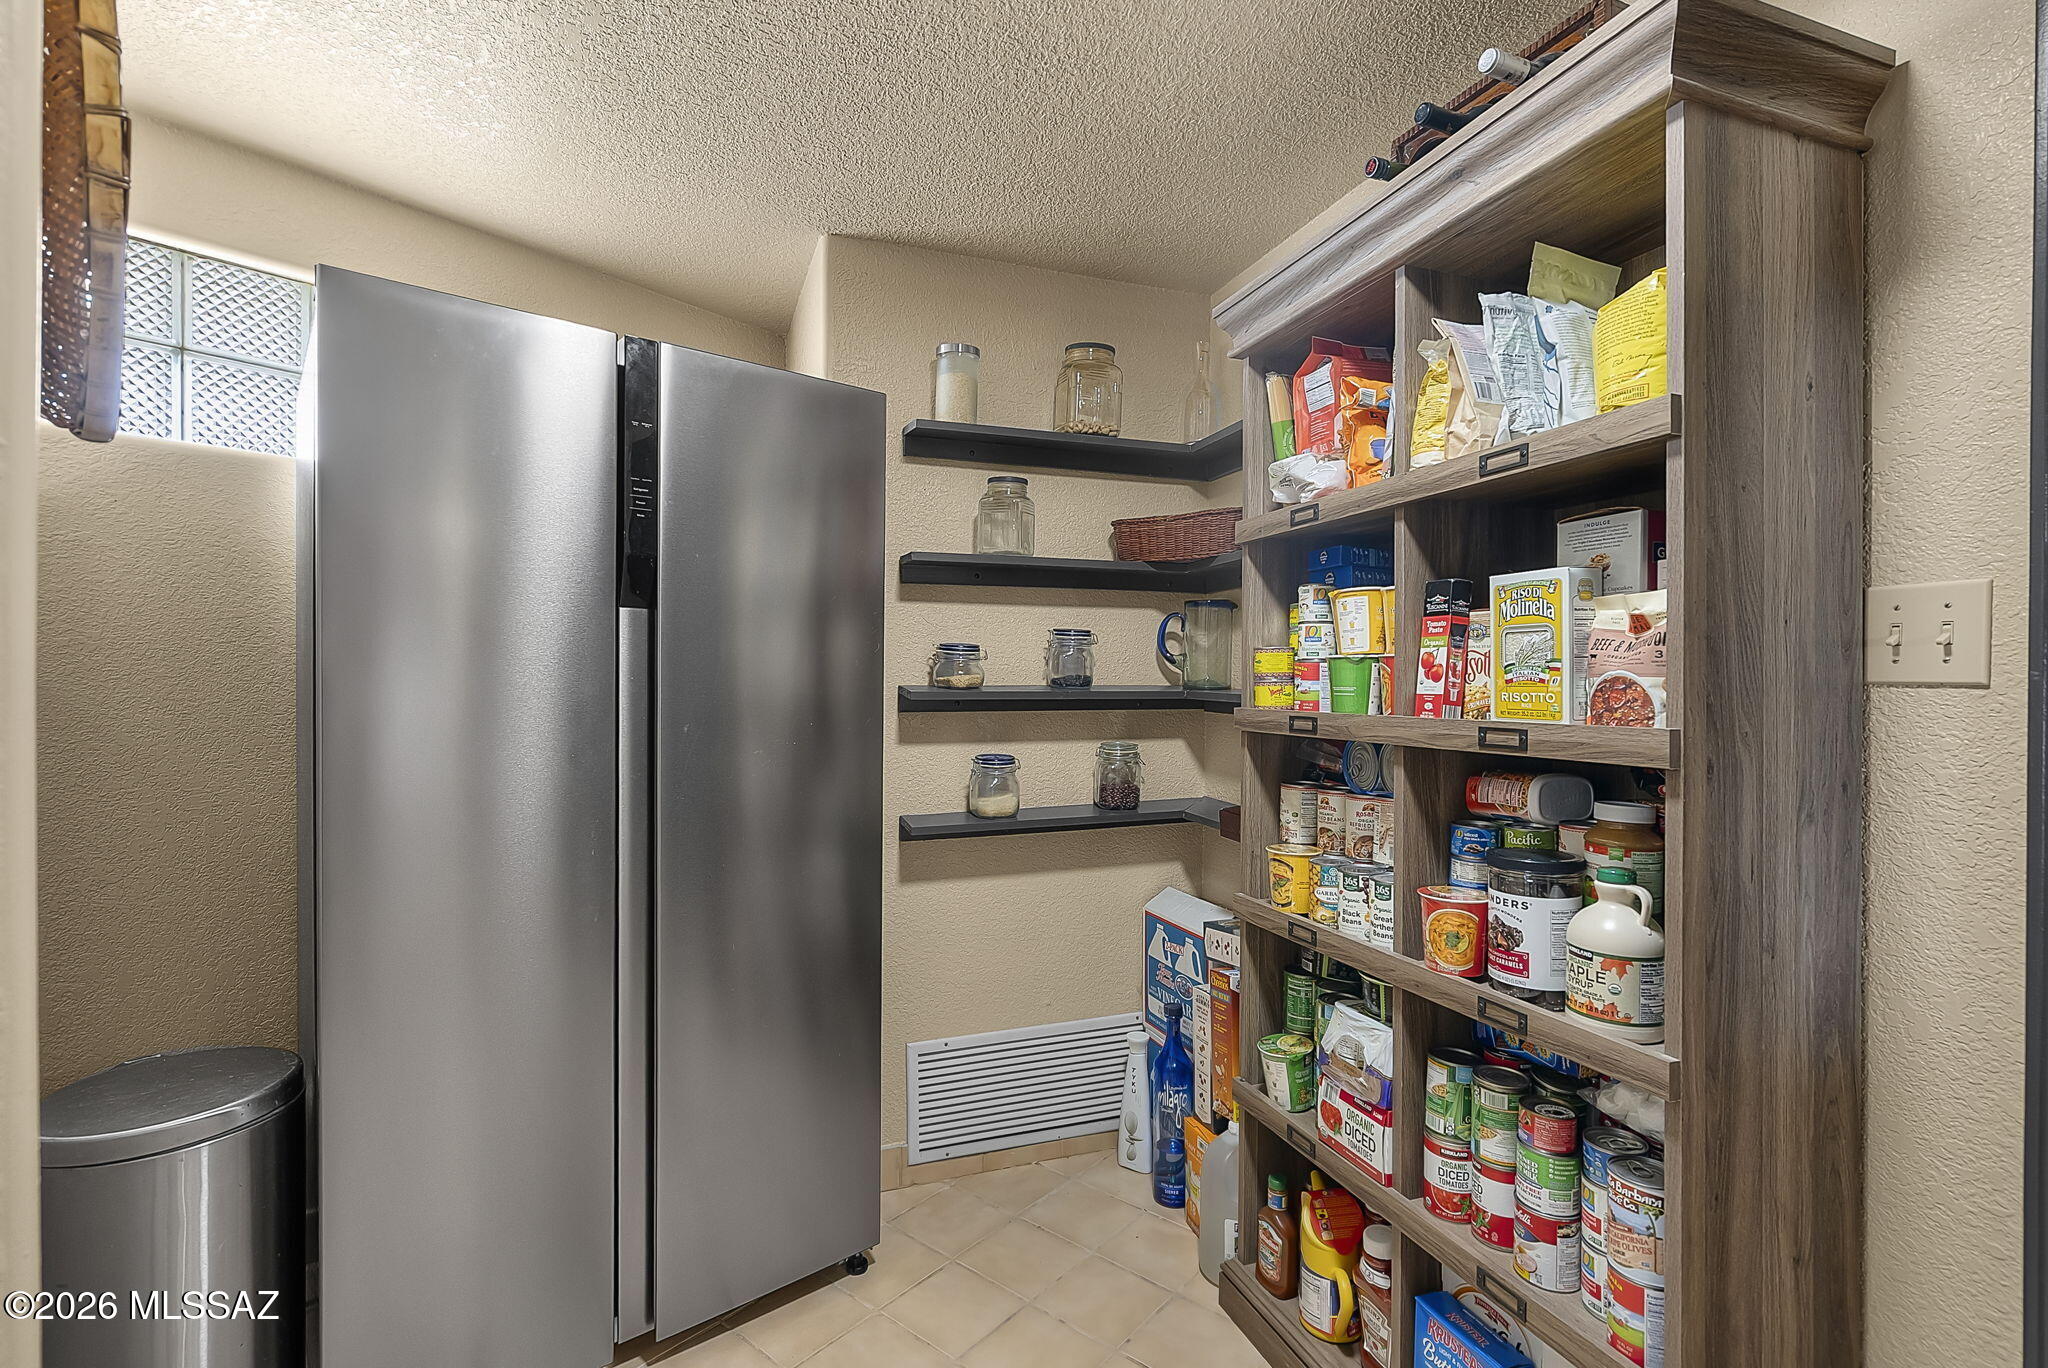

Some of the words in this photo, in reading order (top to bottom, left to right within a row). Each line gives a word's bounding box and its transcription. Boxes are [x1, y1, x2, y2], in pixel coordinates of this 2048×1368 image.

[1584, 519, 1611, 528] INDULGE
[1511, 587, 1533, 601] RISO
[1533, 587, 1542, 598] DI
[1607, 585, 1634, 593] Cupcakes
[1499, 598, 1556, 627] Molinella
[1426, 620, 1447, 628] Tomato
[1423, 639, 1445, 648] Organic
[1590, 638, 1616, 651] BEEF
[1654, 650, 1664, 659] 3
[1512, 670, 1540, 678] ITALIAN
[1501, 691, 1556, 703] RISOTTO
[1505, 830, 1542, 845] Pacific
[1343, 876, 1358, 887] 365
[1316, 889, 1338, 897] GARBA
[1375, 885, 1390, 896] 365
[1341, 895, 1361, 904] Organic
[1490, 894, 1529, 910] NDERS
[1342, 908, 1361, 918] Black
[1373, 904, 1392, 914] Organic
[1341, 916, 1362, 926] Beans
[1373, 913, 1393, 923] Great
[1372, 929, 1394, 940] Beans
[1496, 957, 1524, 970] CARAMELS
[1568, 962, 1607, 985] APLE
[1568, 974, 1594, 989] SYRUP
[1157, 1080, 1188, 1129] milagro
[1346, 1107, 1375, 1136] ORGANIC
[1344, 1120, 1376, 1153] DICED
[1347, 1137, 1373, 1163] TOMATOES
[1440, 1147, 1469, 1158] KIRKLAND
[1440, 1159, 1468, 1171] ORGANIC
[1437, 1166, 1470, 1182] DICED
[1438, 1176, 1469, 1190] TOMATOES
[1616, 1182, 1662, 1208] Barbara
[1610, 1230, 1649, 1247] CALIFORNIA
[1621, 1242, 1653, 1255] OLIVES
[1427, 1316, 1484, 1368] KRUSTEA
